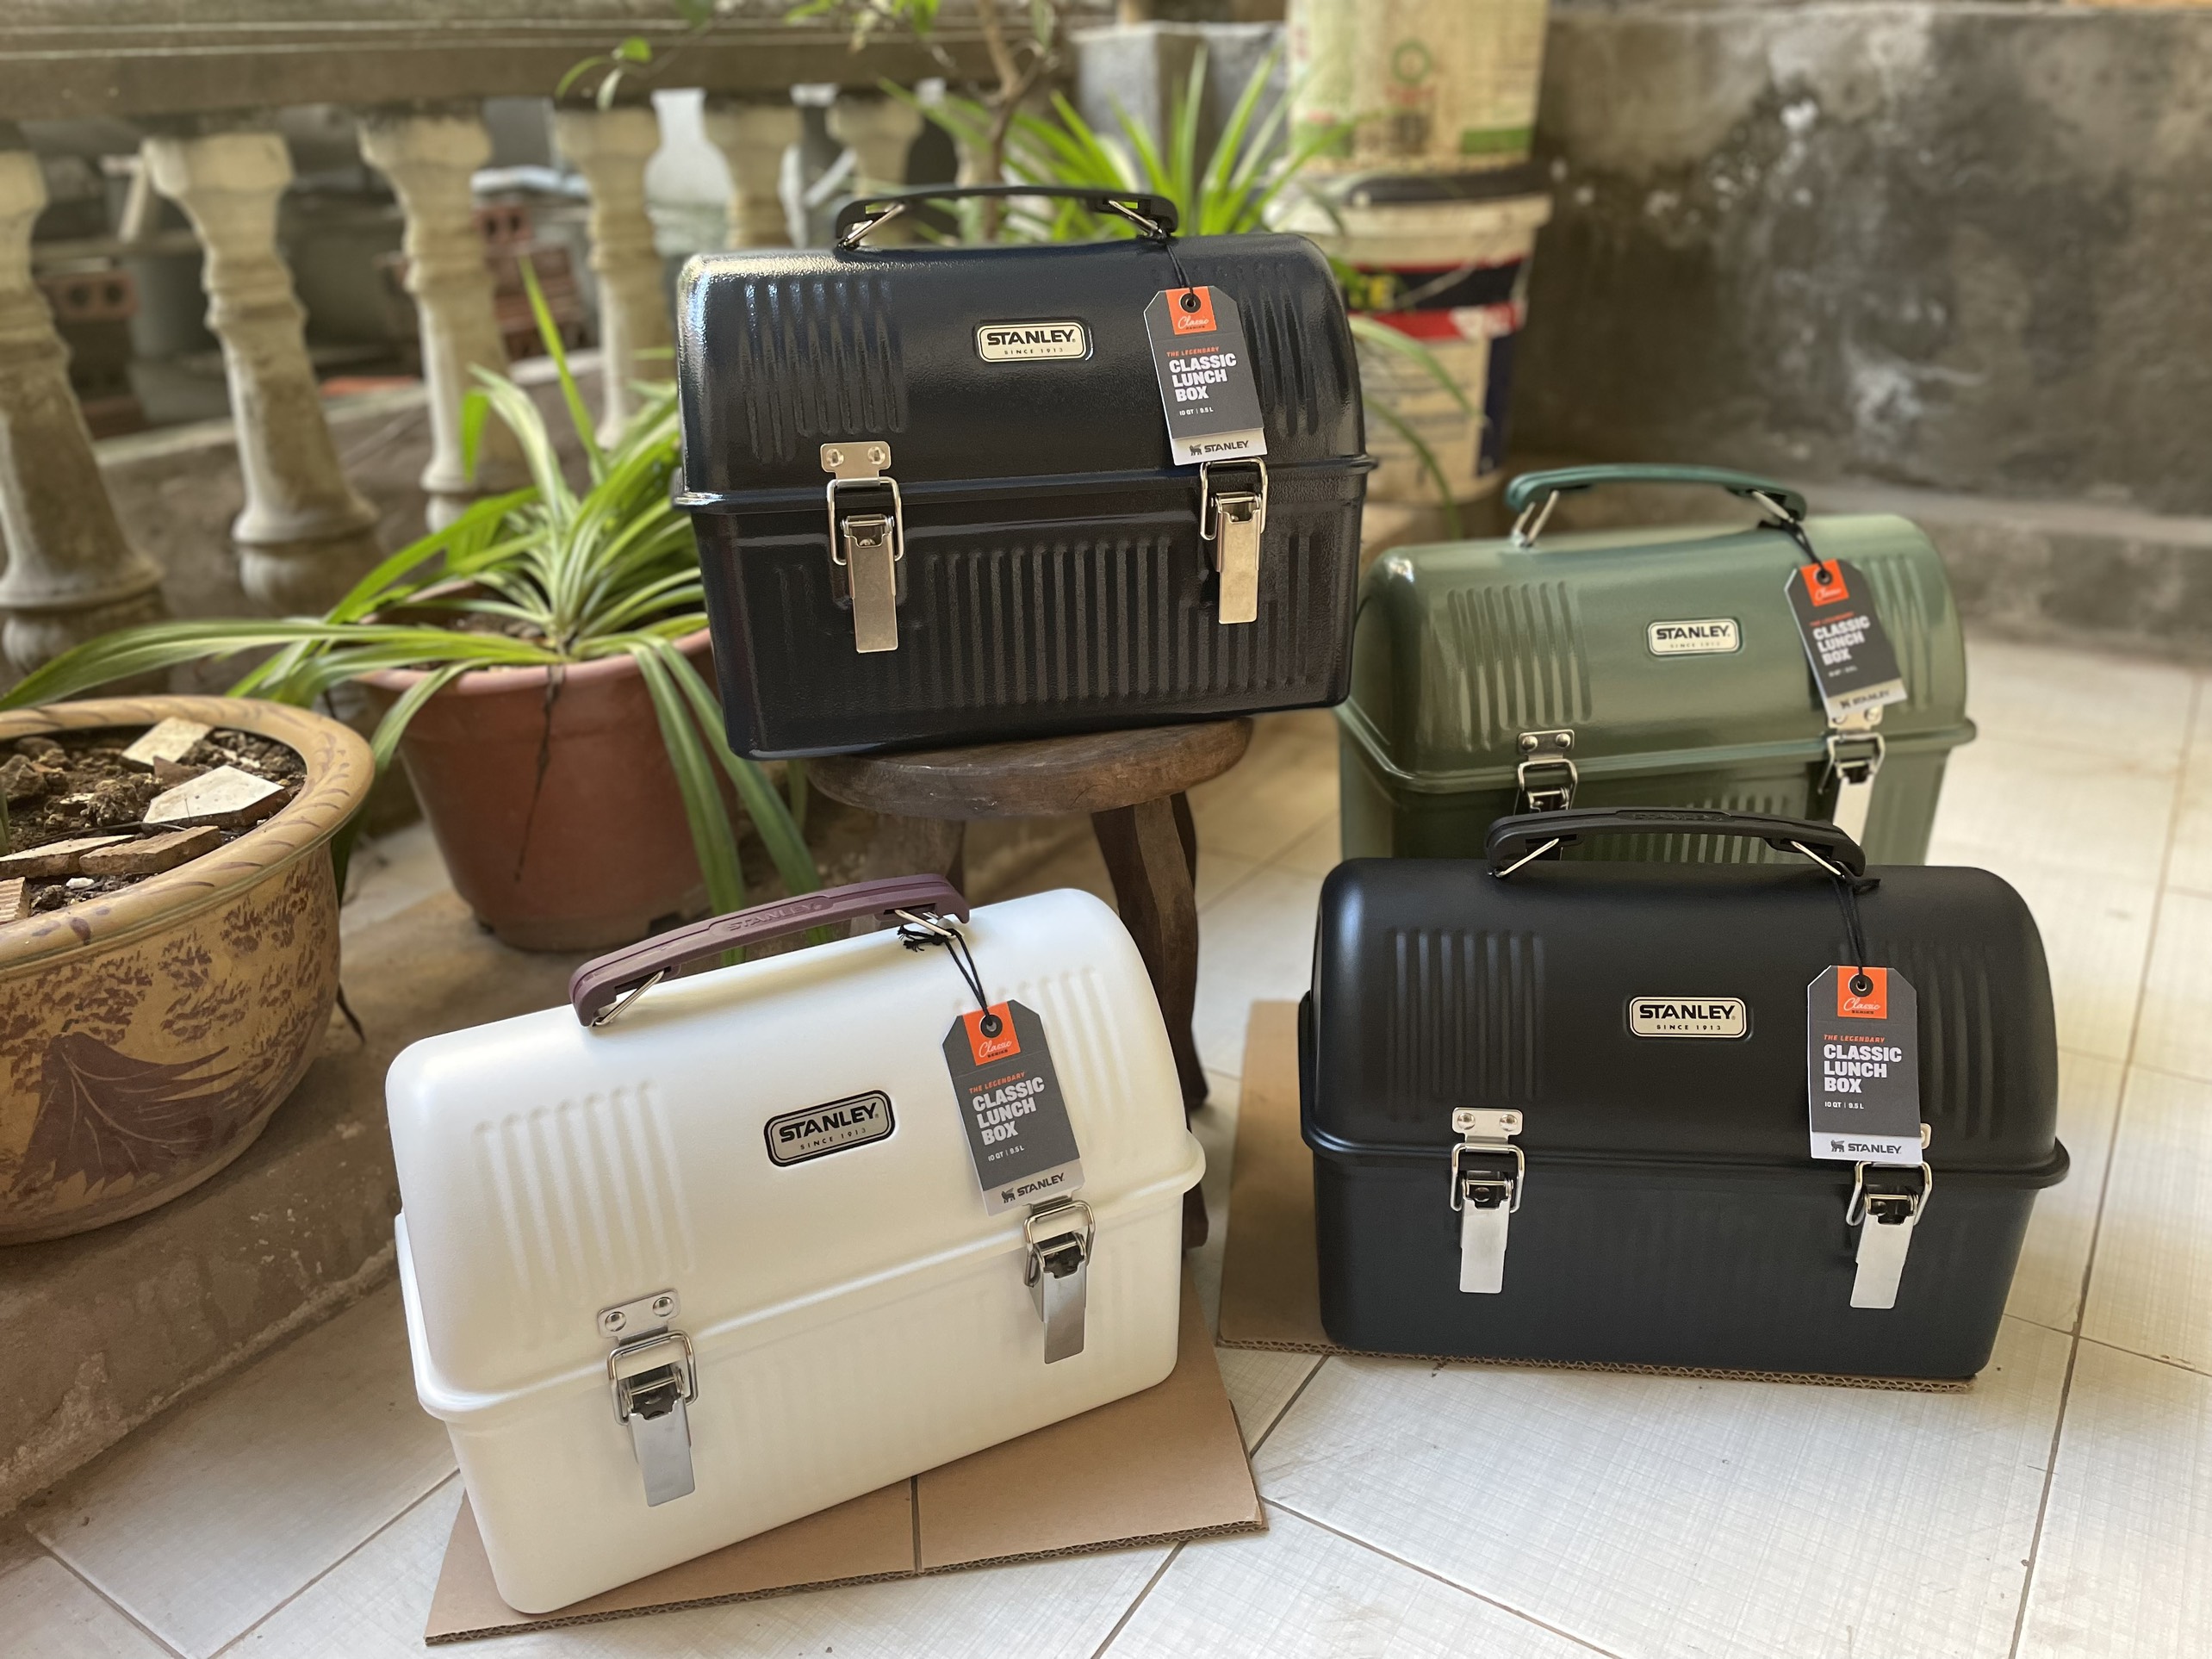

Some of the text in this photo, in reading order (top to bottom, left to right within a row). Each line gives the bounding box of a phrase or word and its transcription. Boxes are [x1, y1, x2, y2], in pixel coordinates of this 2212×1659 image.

[1177, 315, 1209, 330] Classic
[986, 329, 1074, 345] STANLEY
[1181, 346, 1220, 356] LEGENDARY
[1169, 353, 1237, 373] CLASSIC
[1171, 369, 1227, 388] LUNCH
[1175, 386, 1209, 402] BOX
[1204, 440, 1249, 453] STANLEY
[1656, 625, 1730, 640] STANLEY
[1812, 615, 1870, 641] CLASSIC
[1817, 631, 1865, 653] LUNCH
[1822, 648, 1852, 666] BOX
[1639, 1004, 1736, 1020] STANLEY
[1843, 997, 1881, 1011] Classic
[979, 1038, 1012, 1058] Classic
[1840, 1035, 1886, 1044] LEGENDARY
[1824, 1044, 1902, 1063] CLASSIC
[1824, 1060, 1887, 1078] LUNCH
[969, 1072, 1025, 1094] THE LEGENDARY
[1824, 1077, 1862, 1094] BOX
[972, 1077, 1045, 1111] CLASSIC
[976, 1097, 1036, 1129] LUNCH
[779, 1102, 877, 1143] STANLEY
[800, 1128, 867, 1150] SINCE 1913
[981, 1121, 1018, 1146] BOX
[995, 1151, 1004, 1159] QT
[1010, 1146, 1020, 1155] 9.5
[1848, 1143, 1902, 1154] STANLEY
[1017, 1171, 1065, 1197] STANLEY
